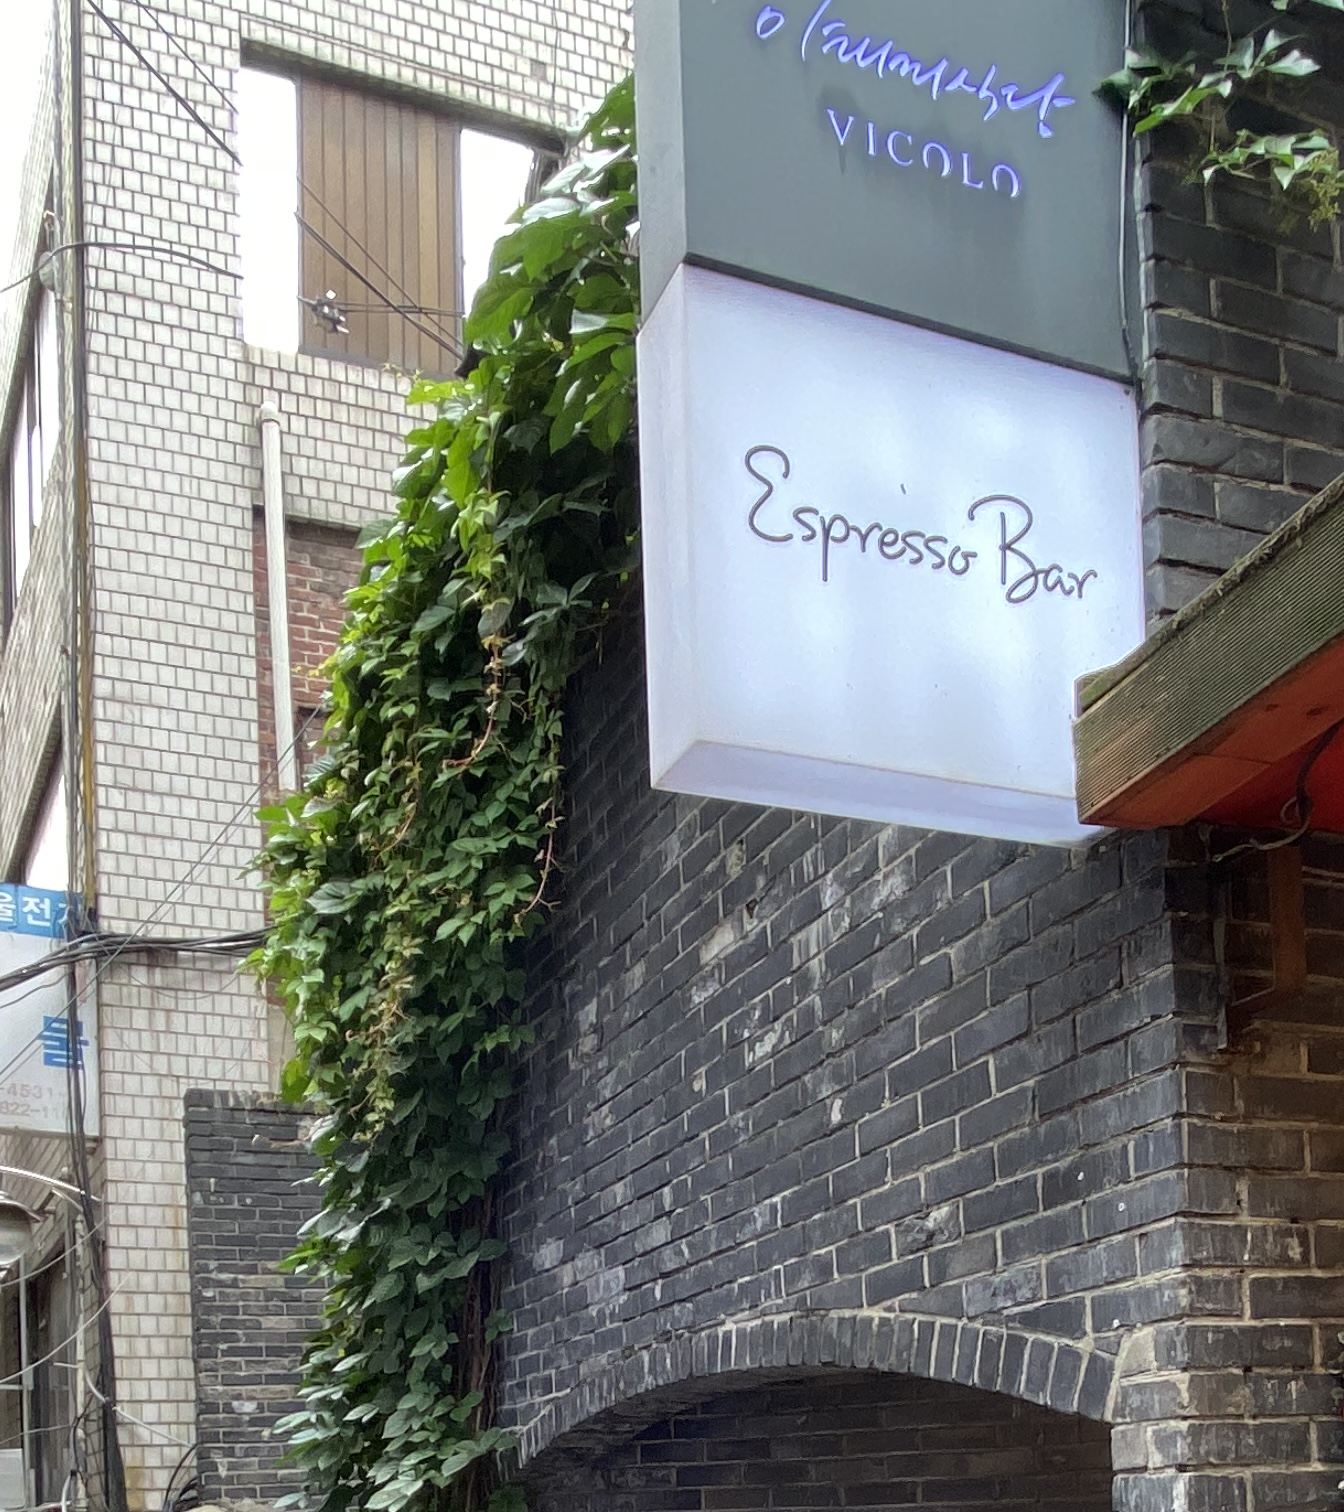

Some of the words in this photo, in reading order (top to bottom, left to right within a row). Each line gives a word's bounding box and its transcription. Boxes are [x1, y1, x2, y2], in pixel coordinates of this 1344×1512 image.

[825, 108, 1021, 199] VICOLO
[744, 445, 979, 582] Espresso
[967, 495, 1099, 604] Bar
